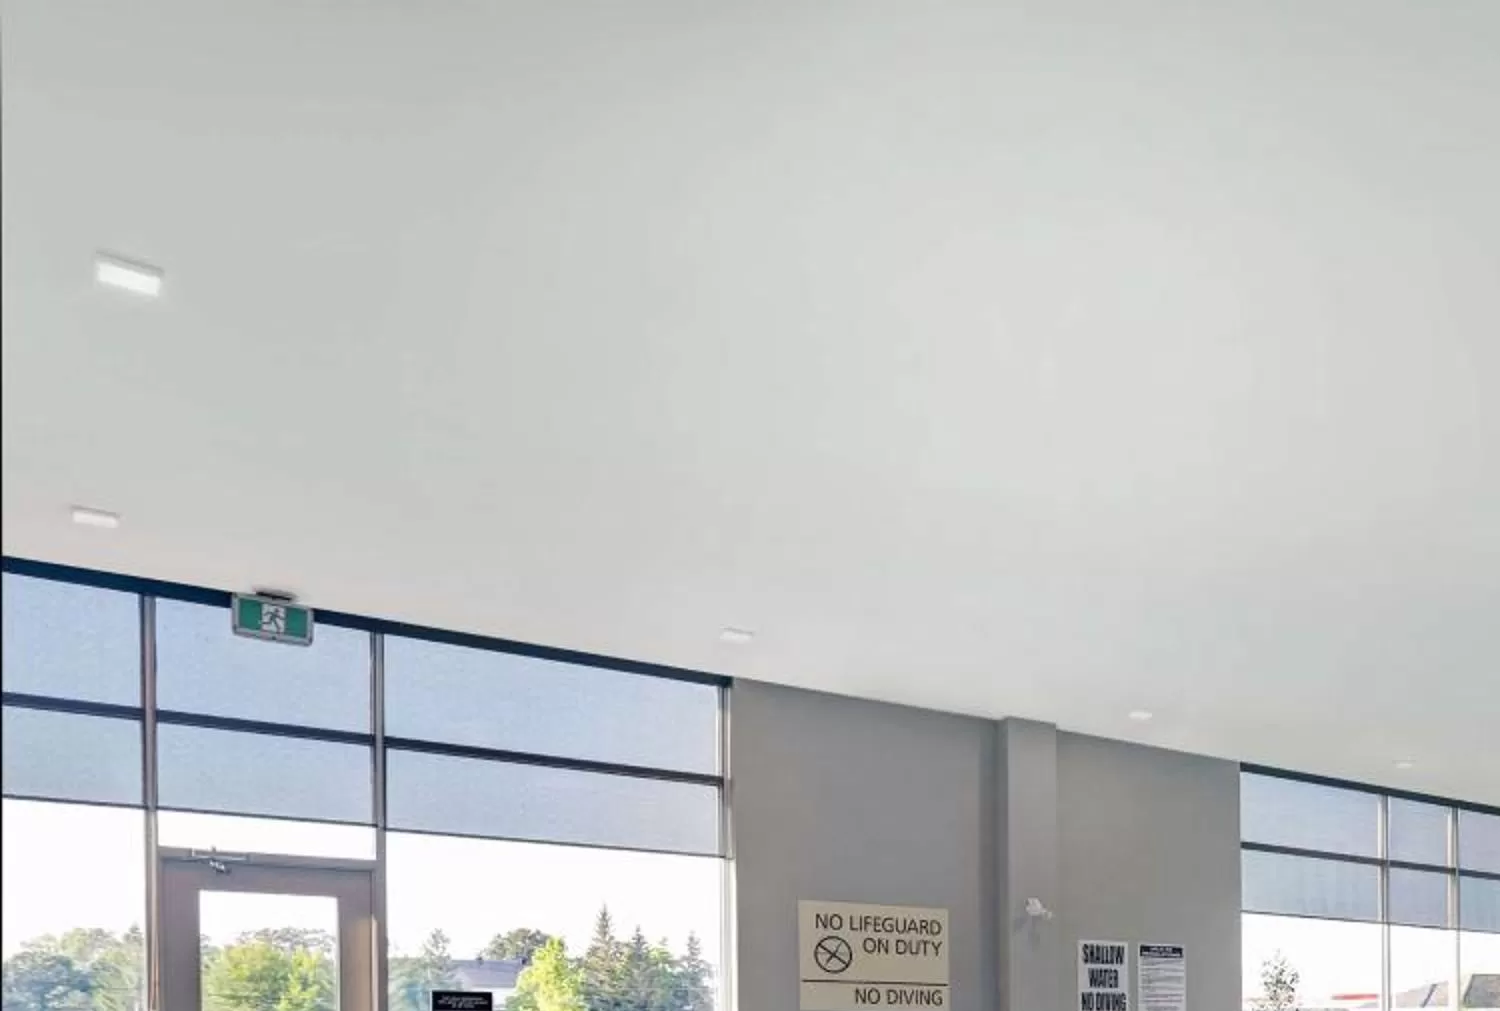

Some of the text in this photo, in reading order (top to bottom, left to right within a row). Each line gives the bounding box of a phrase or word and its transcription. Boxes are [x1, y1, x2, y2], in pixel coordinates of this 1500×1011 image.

[815, 913, 943, 936] NO LIFEGUARD
[862, 937, 943, 957] ON DUTY
[1088, 967, 1119, 989] WATER
[855, 988, 943, 1007] NO DIVING
